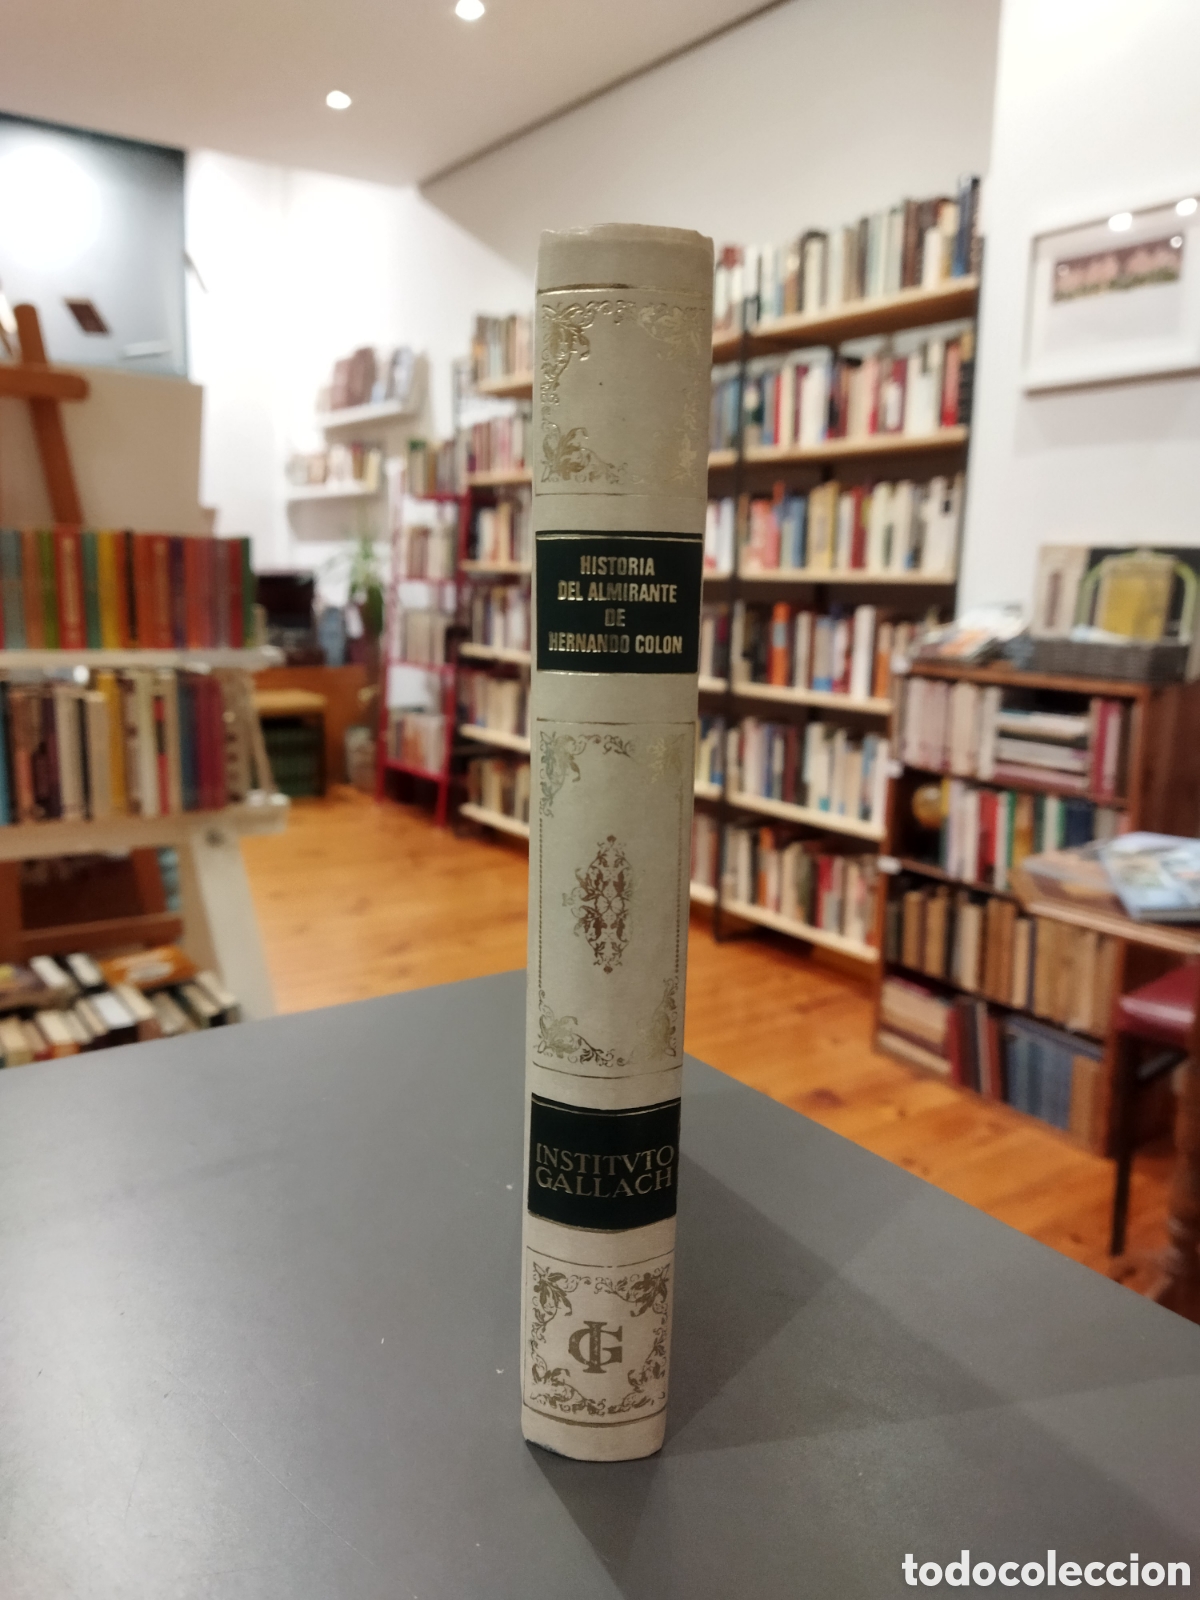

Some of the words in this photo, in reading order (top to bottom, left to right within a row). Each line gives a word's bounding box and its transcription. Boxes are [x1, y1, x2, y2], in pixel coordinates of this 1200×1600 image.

[580, 555, 655, 576] HISTORIA
[557, 580, 584, 601] DEL
[588, 582, 677, 603] ALMIRANTE
[604, 608, 626, 627] DE
[548, 631, 630, 653] HERNANDO
[635, 635, 683, 654] COLON
[536, 1143, 675, 1176] INSTITVTO
[535, 1166, 672, 1198] GALLACH
